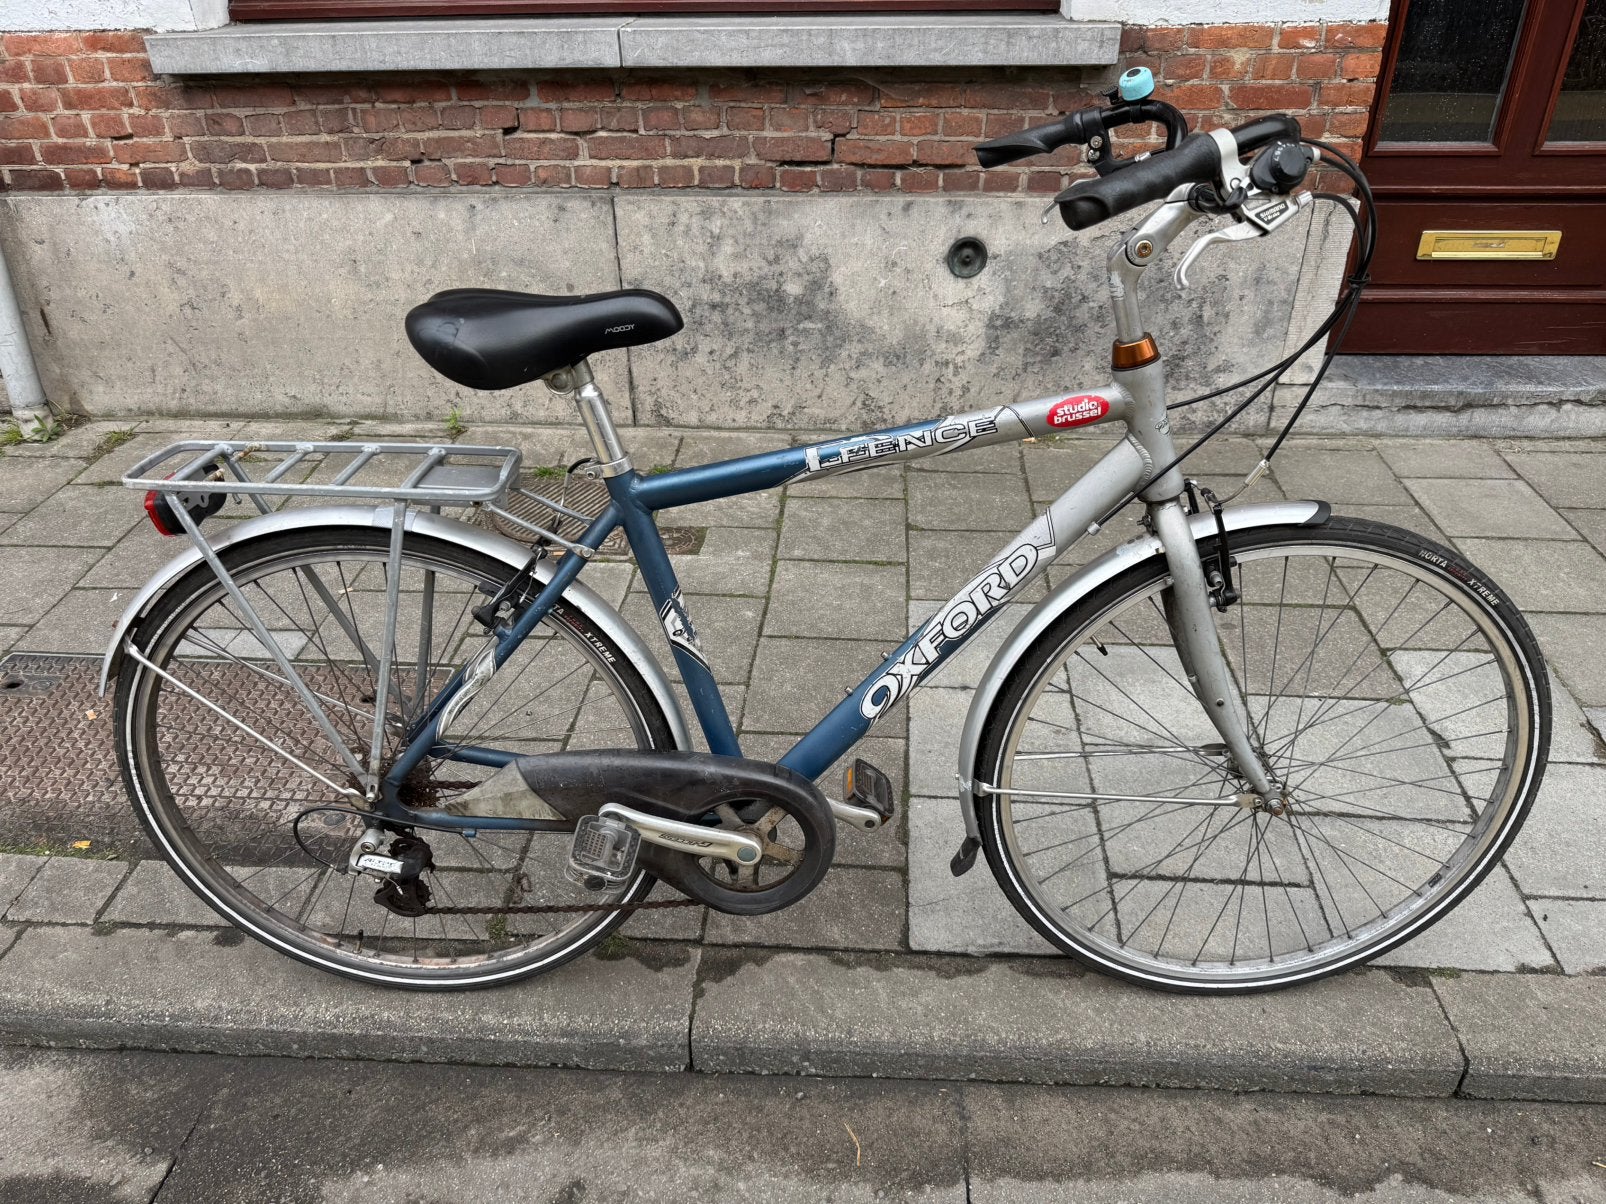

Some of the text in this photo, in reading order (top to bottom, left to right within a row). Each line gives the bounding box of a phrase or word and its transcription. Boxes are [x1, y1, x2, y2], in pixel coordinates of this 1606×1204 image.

[1053, 406, 1102, 425] brussel
[1056, 398, 1099, 417] studio
[1467, 577, 1500, 606] XTREME
[860, 543, 1039, 720] OXFORD
[584, 631, 617, 664] XTREME
